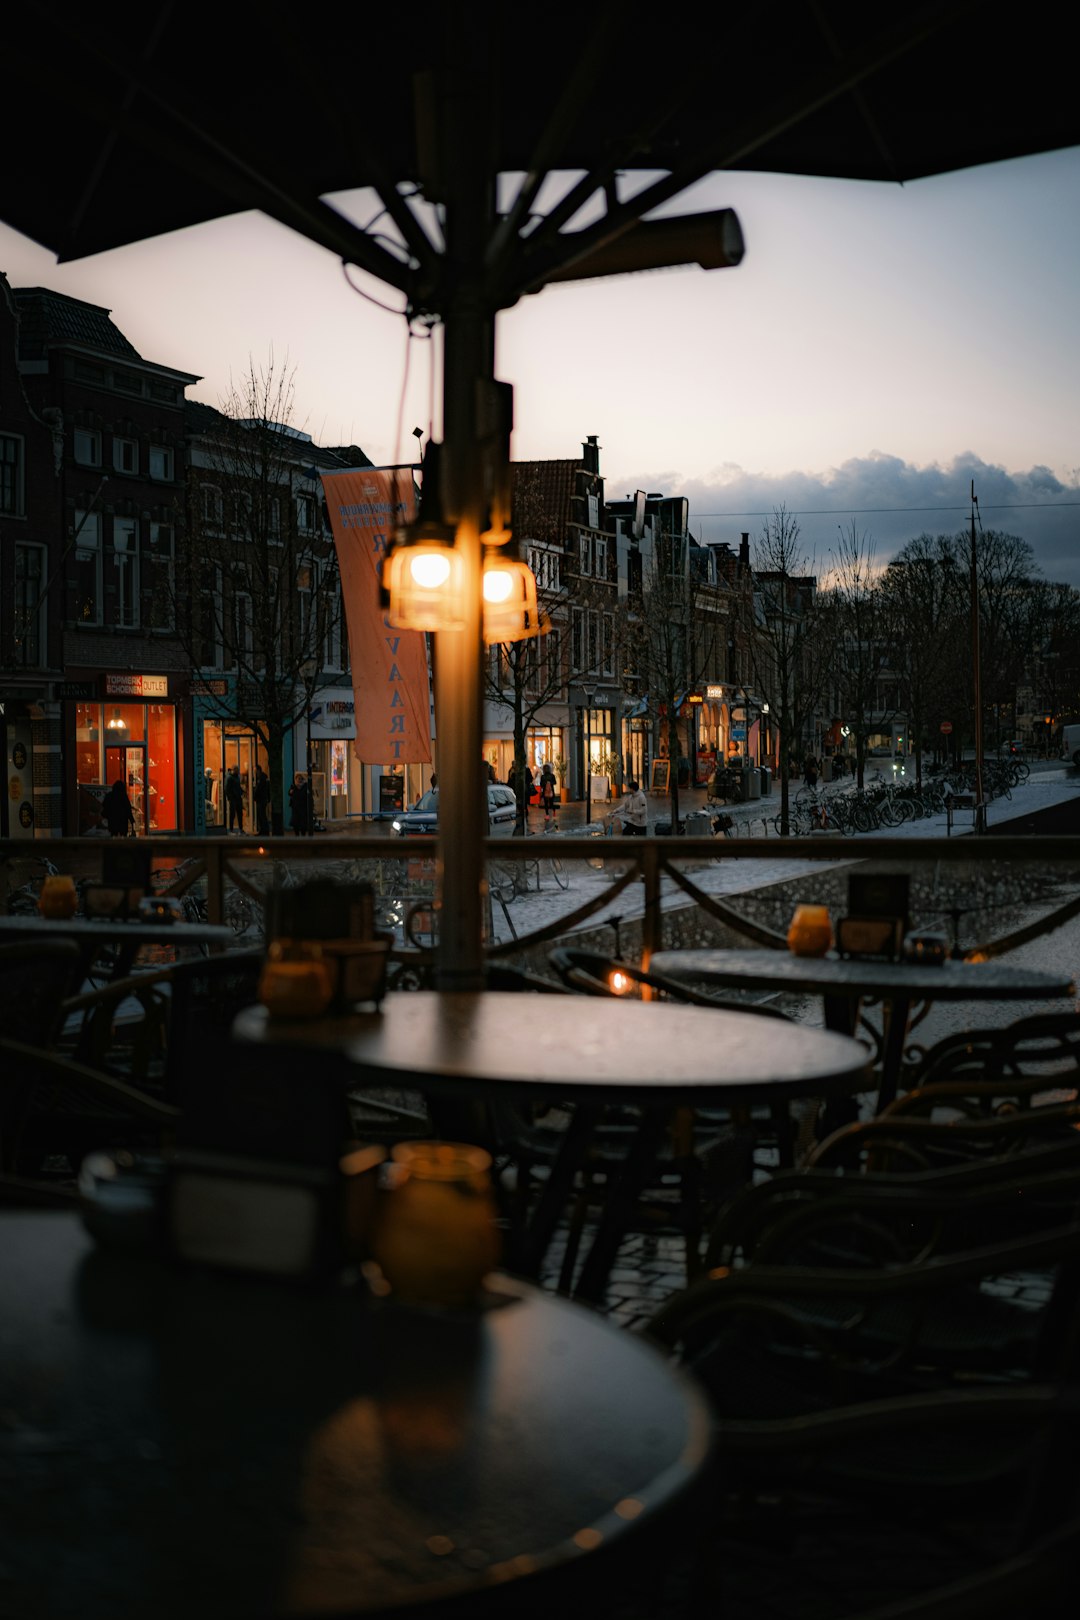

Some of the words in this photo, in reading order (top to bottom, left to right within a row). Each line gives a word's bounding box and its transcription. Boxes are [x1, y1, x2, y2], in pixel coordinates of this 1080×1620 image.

[106, 674, 142, 685] TOPMERK
[106, 685, 142, 695] SCHOENEN
[143, 681, 166, 691] OUTLET
[196, 771, 203, 785] to
